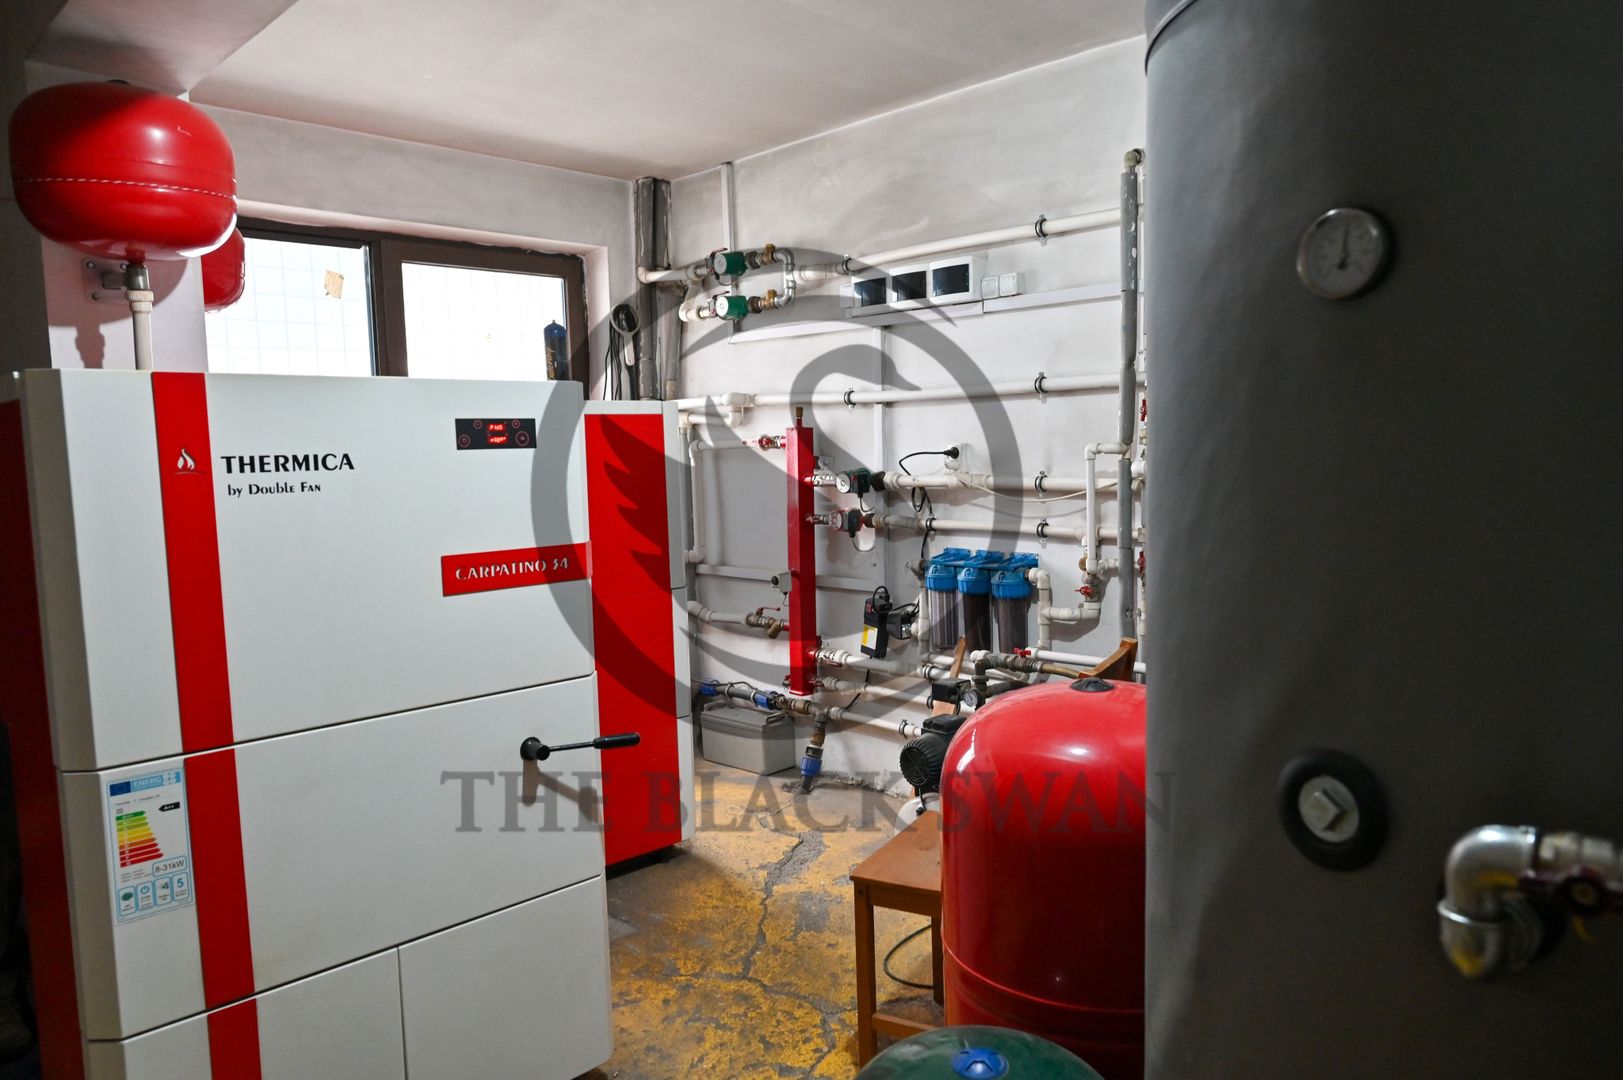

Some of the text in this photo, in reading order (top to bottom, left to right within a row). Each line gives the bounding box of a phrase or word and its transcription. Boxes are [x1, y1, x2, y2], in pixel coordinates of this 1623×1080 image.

[220, 453, 355, 474] THERMICA
[227, 484, 243, 498] by
[455, 560, 547, 581] CARPATINO
[133, 776, 162, 788] ENERG
[176, 877, 184, 888] 5
